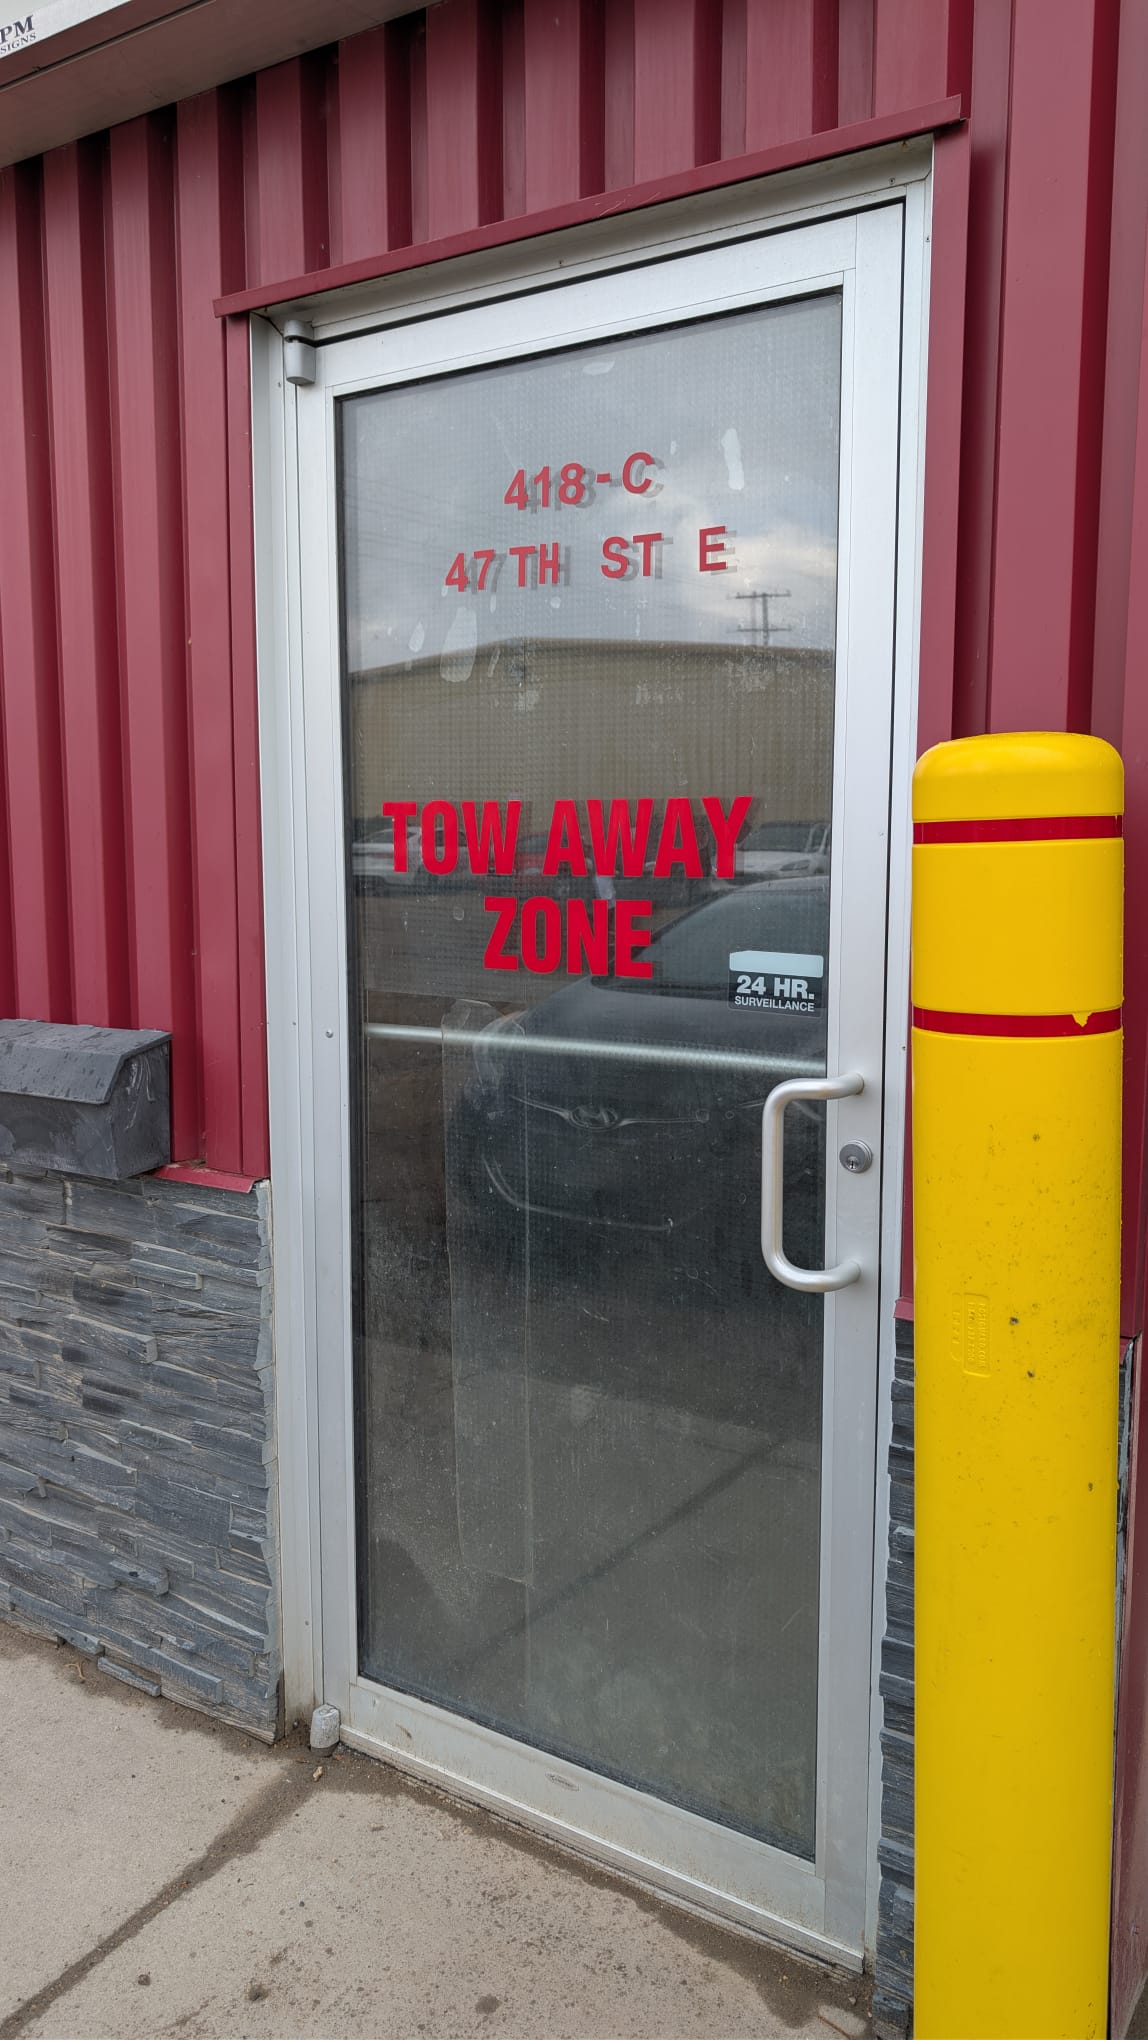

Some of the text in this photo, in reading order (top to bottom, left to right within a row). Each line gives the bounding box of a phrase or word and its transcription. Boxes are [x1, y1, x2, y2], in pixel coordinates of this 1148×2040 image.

[0, 32, 36, 54] SIGNS
[445, 525, 727, 592] 47TH ST E
[382, 796, 753, 878] TOW AWAY
[484, 896, 653, 978] ZONE
[734, 996, 815, 1012] SURVEILLANCE
[736, 974, 815, 1000] 24 HR.
